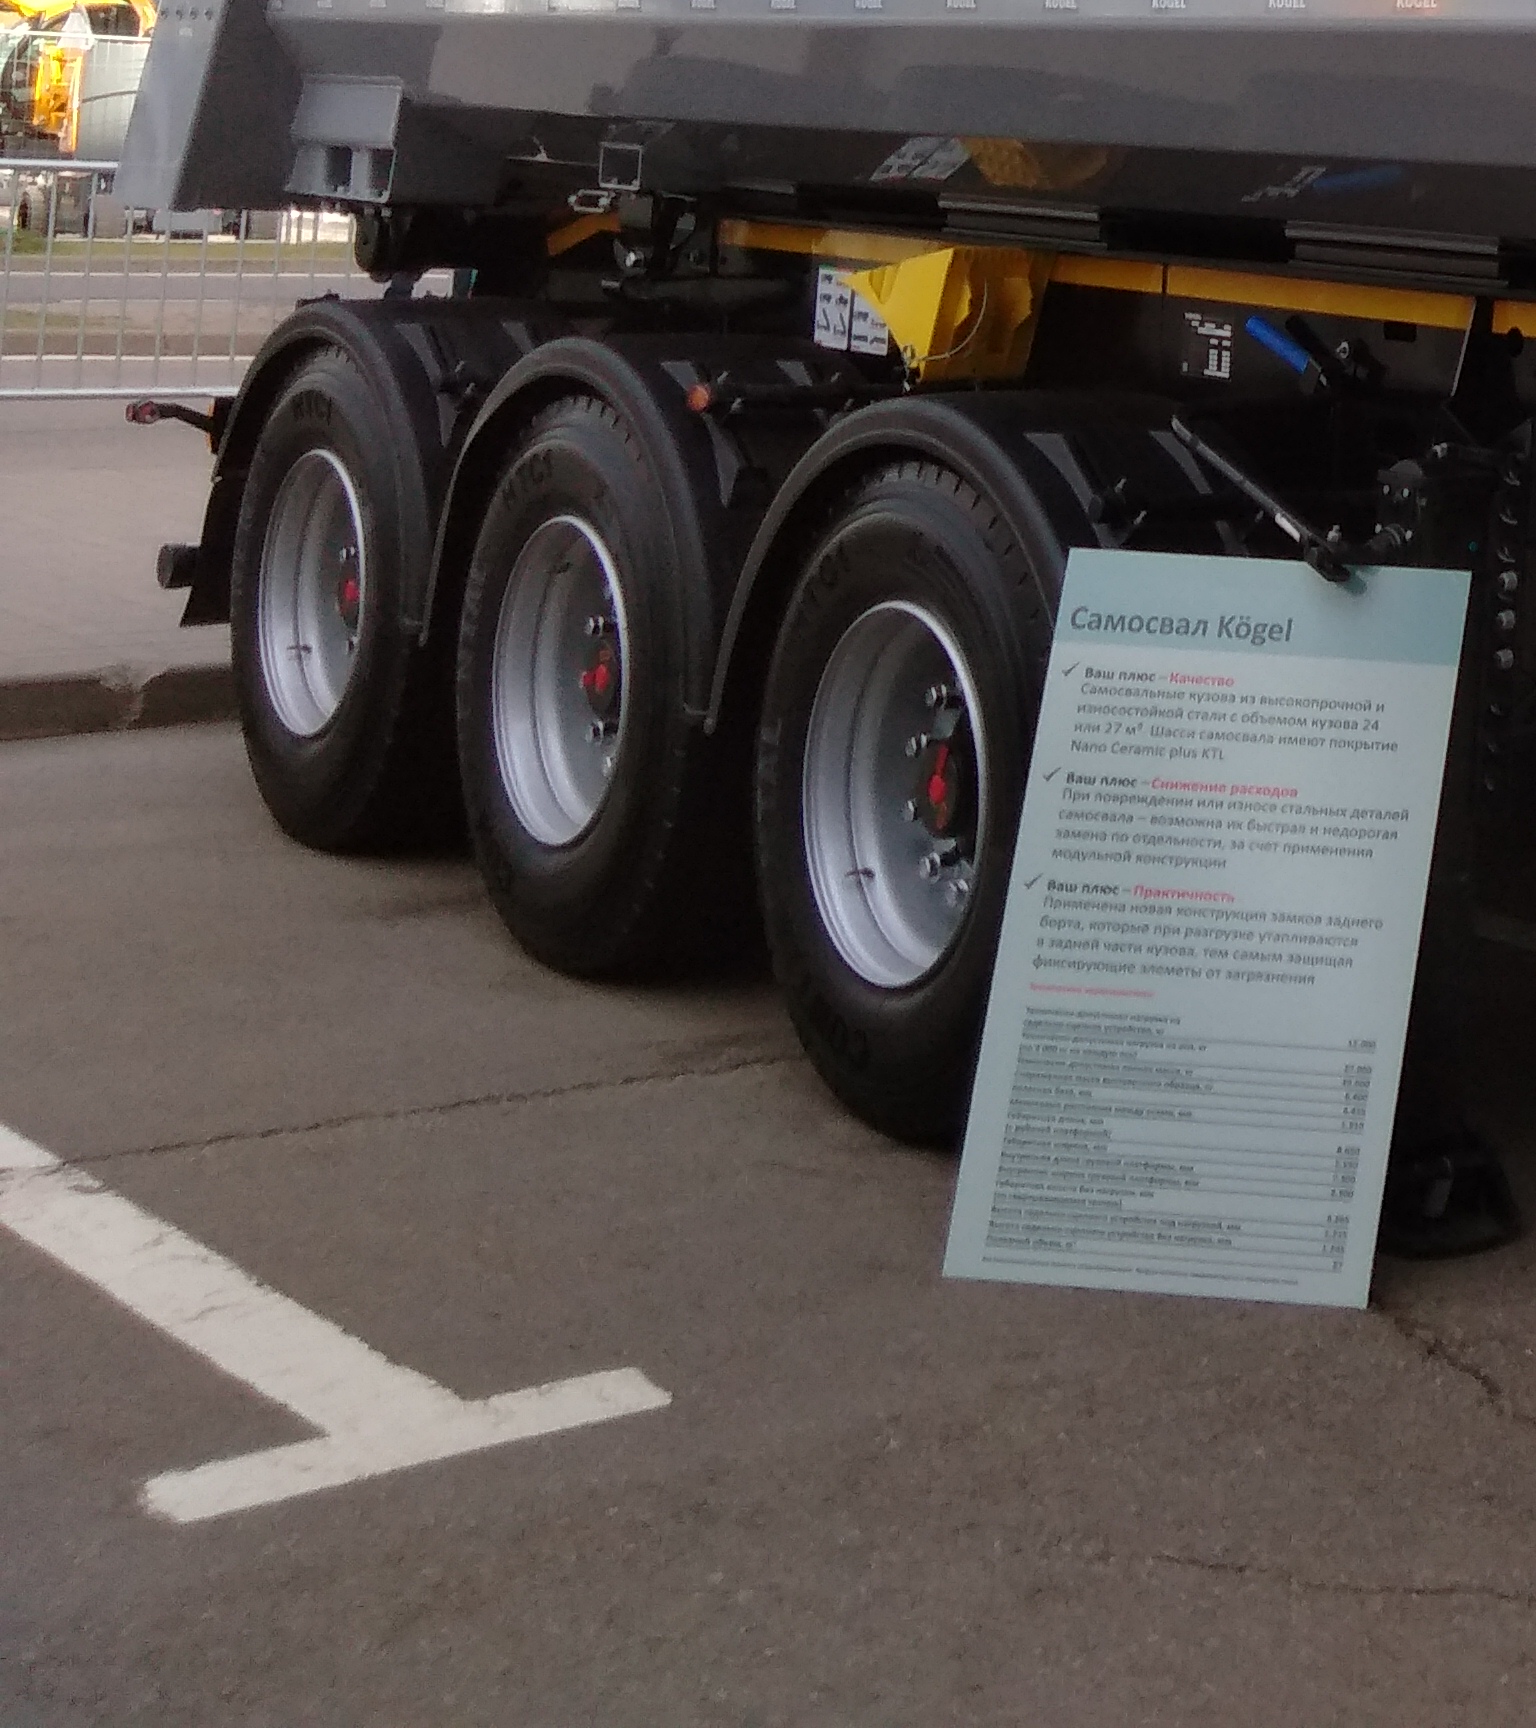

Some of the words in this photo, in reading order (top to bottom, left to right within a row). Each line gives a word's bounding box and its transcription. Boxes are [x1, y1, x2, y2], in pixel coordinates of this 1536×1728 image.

[1070, 606, 1208, 638] Самосвал
[1216, 615, 1293, 645] Kögel
[1084, 665, 1115, 680] Ваш
[1117, 670, 1156, 683] плюс
[1169, 671, 1235, 687] Качество
[1103, 720, 1122, 734] 27
[1361, 717, 1379, 731] 24
[1070, 737, 1107, 753] Nano
[1110, 740, 1166, 757] Ceramic
[1168, 745, 1197, 759] plus
[1201, 746, 1224, 761] KTL
[1065, 770, 1096, 786] Ваш
[1099, 775, 1138, 789] плюс
[1046, 878, 1078, 893] Ваш
[1080, 882, 1119, 896] плюс
